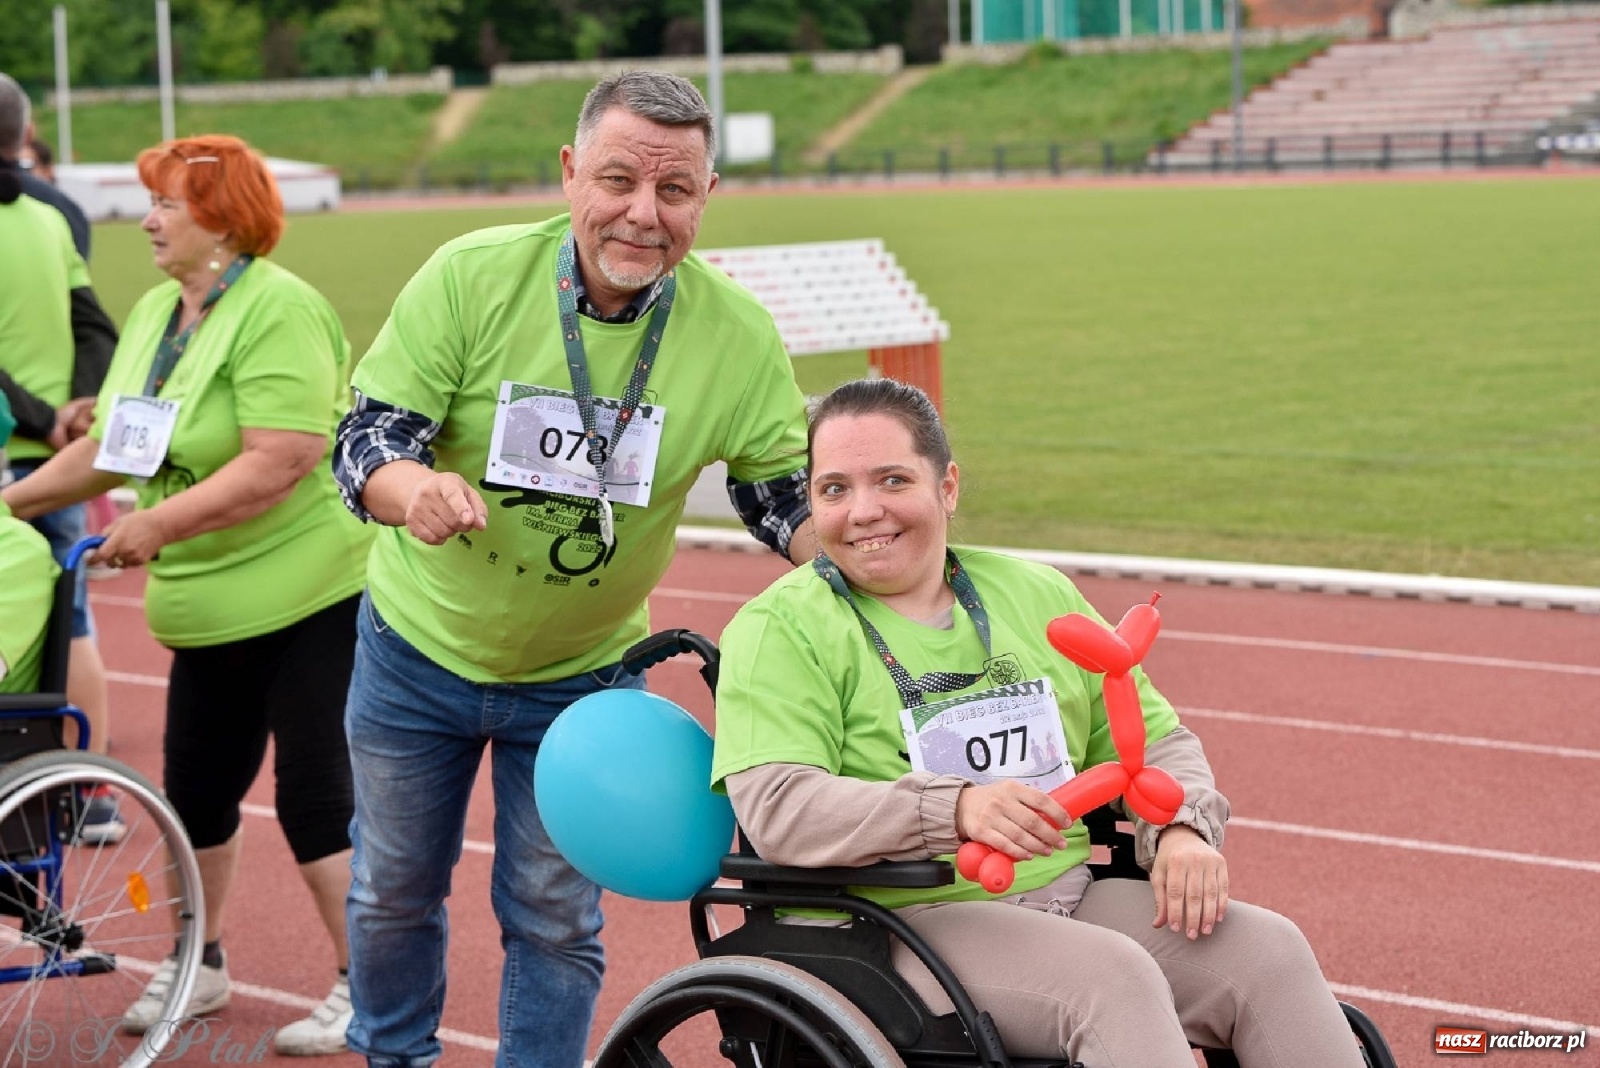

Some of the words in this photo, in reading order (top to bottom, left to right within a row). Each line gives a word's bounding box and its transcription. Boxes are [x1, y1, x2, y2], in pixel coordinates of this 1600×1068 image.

[121, 424, 148, 449] 018
[526, 506, 542, 518] IM.
[542, 512, 579, 527] JURKA
[543, 500, 567, 513] BIEG
[569, 503, 589, 517] BEZ
[522, 517, 605, 542] WIŚNIEWSKIEGO
[935, 711, 954, 727] VII
[955, 705, 985, 722] BIEG
[986, 699, 1010, 715] BEZ
[966, 725, 1028, 772] 077
